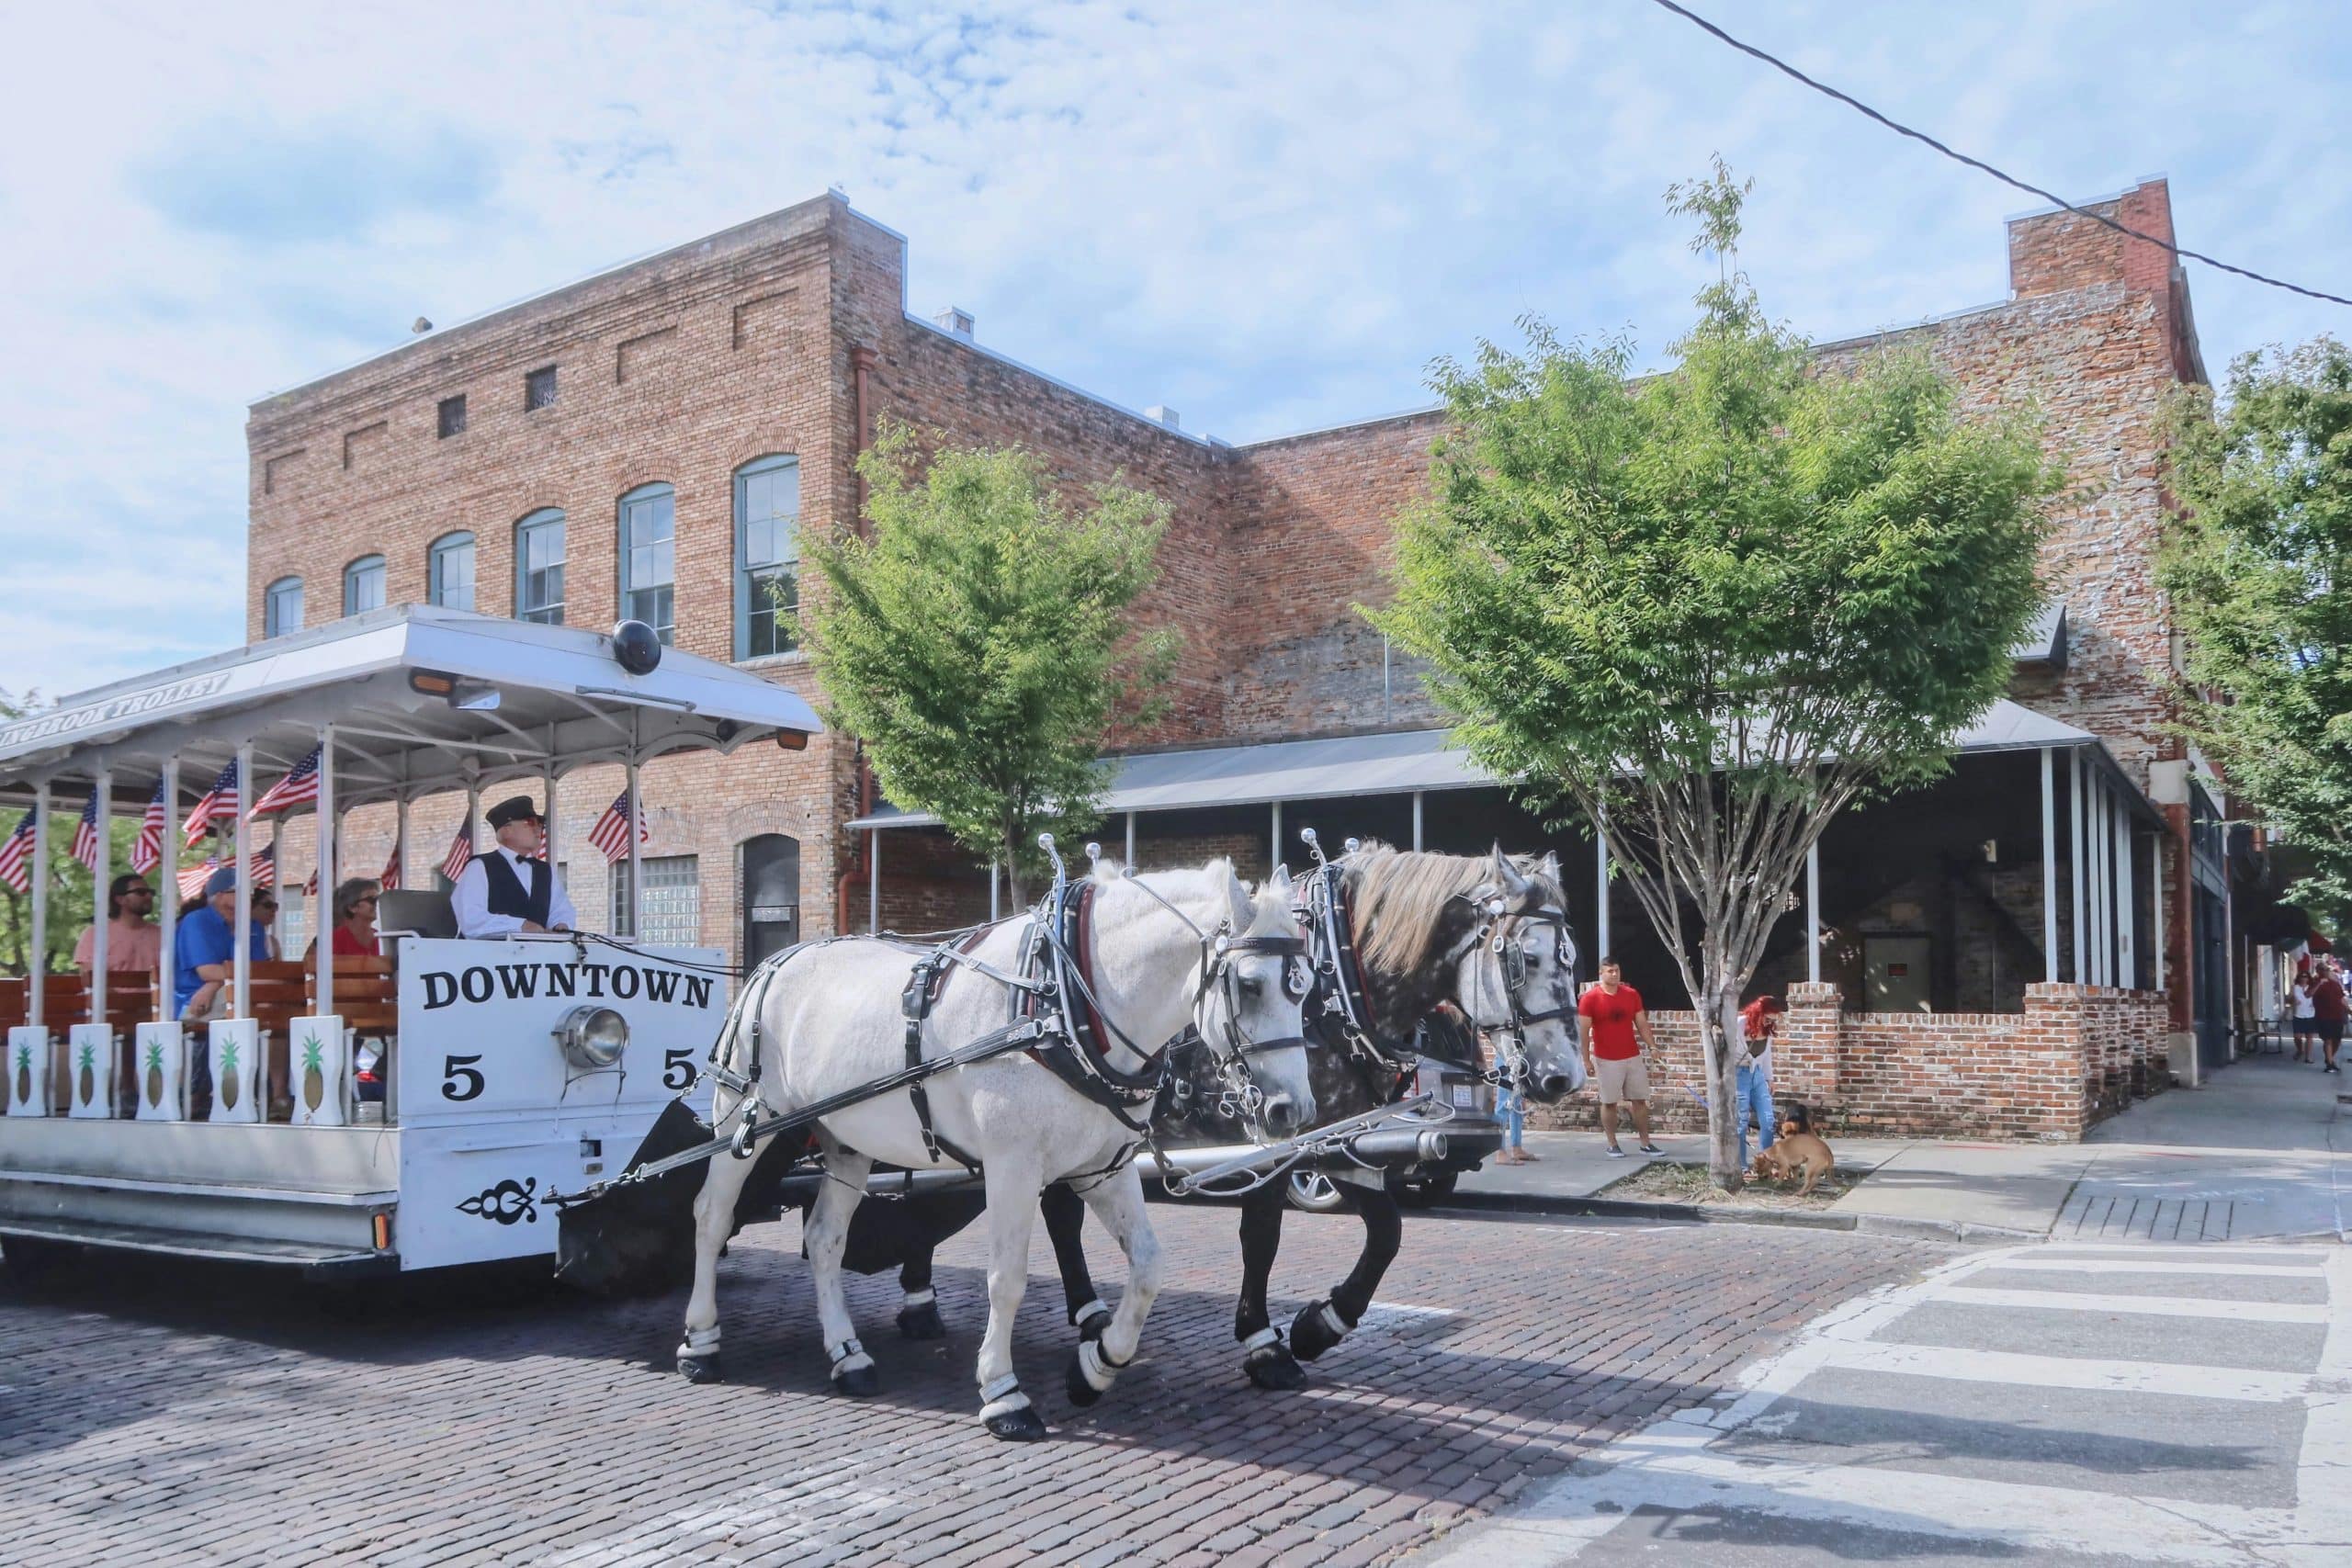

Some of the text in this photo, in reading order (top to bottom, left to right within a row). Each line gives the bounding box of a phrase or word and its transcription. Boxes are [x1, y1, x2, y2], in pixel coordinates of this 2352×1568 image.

[110, 673, 230, 718] TROLLEY
[419, 963, 714, 1010] DOWNTOWN
[441, 1054, 485, 1101] 5
[662, 1047, 697, 1090] 5
